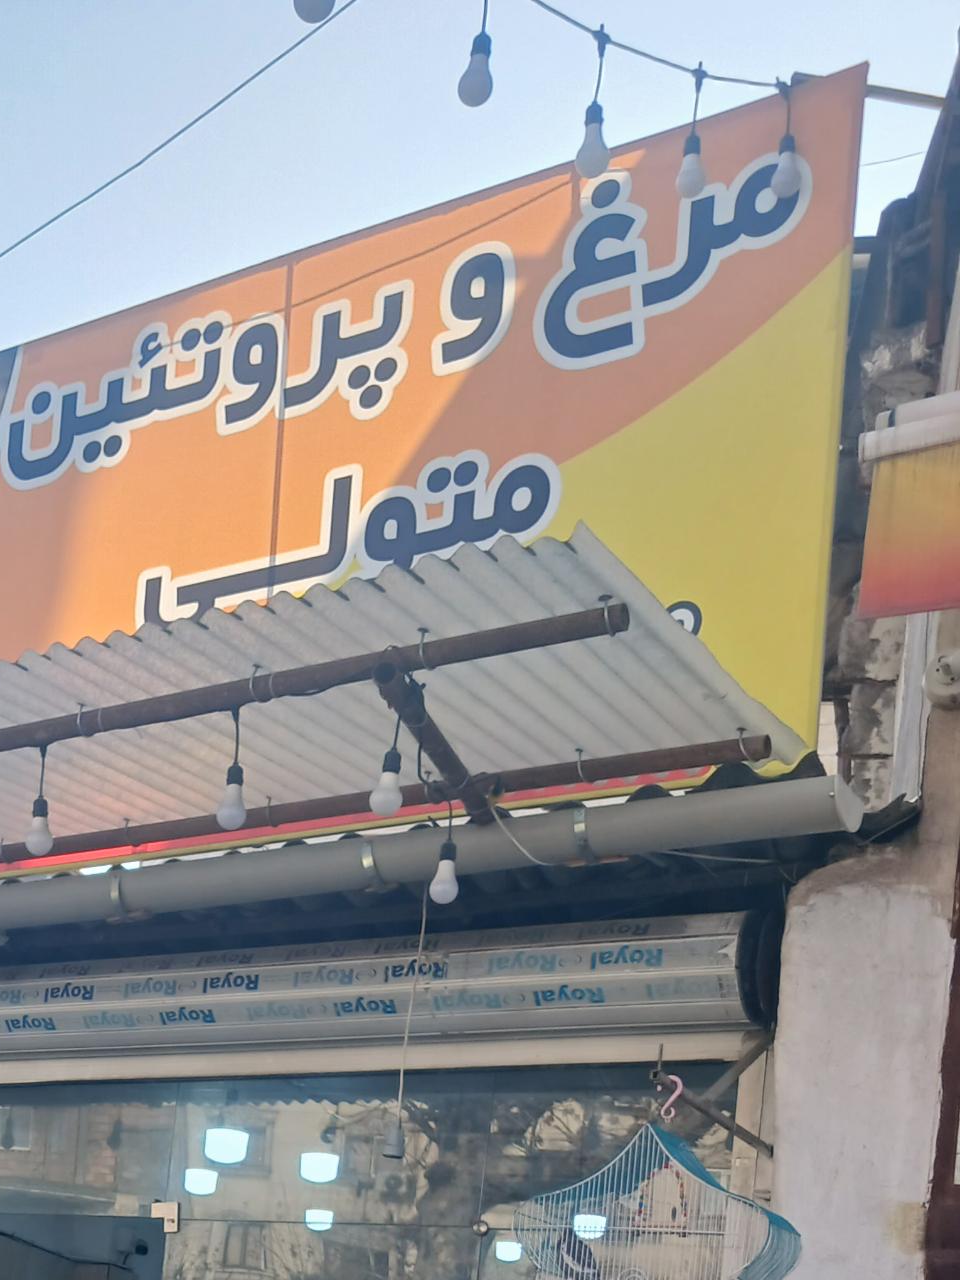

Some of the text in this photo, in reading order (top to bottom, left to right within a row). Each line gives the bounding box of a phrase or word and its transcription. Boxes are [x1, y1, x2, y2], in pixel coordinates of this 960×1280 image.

[5, 156, 806, 486] مرغ و پروتئین
[590, 944, 663, 971] Royal
[384, 959, 448, 983] Royal
[44, 985, 95, 1003] Royal
[203, 974, 260, 993] Royal
[533, 984, 606, 1007] Royal
[159, 1007, 216, 1025] Royal
[335, 996, 398, 1017] Royal
[4, 1016, 57, 1033] Royal
